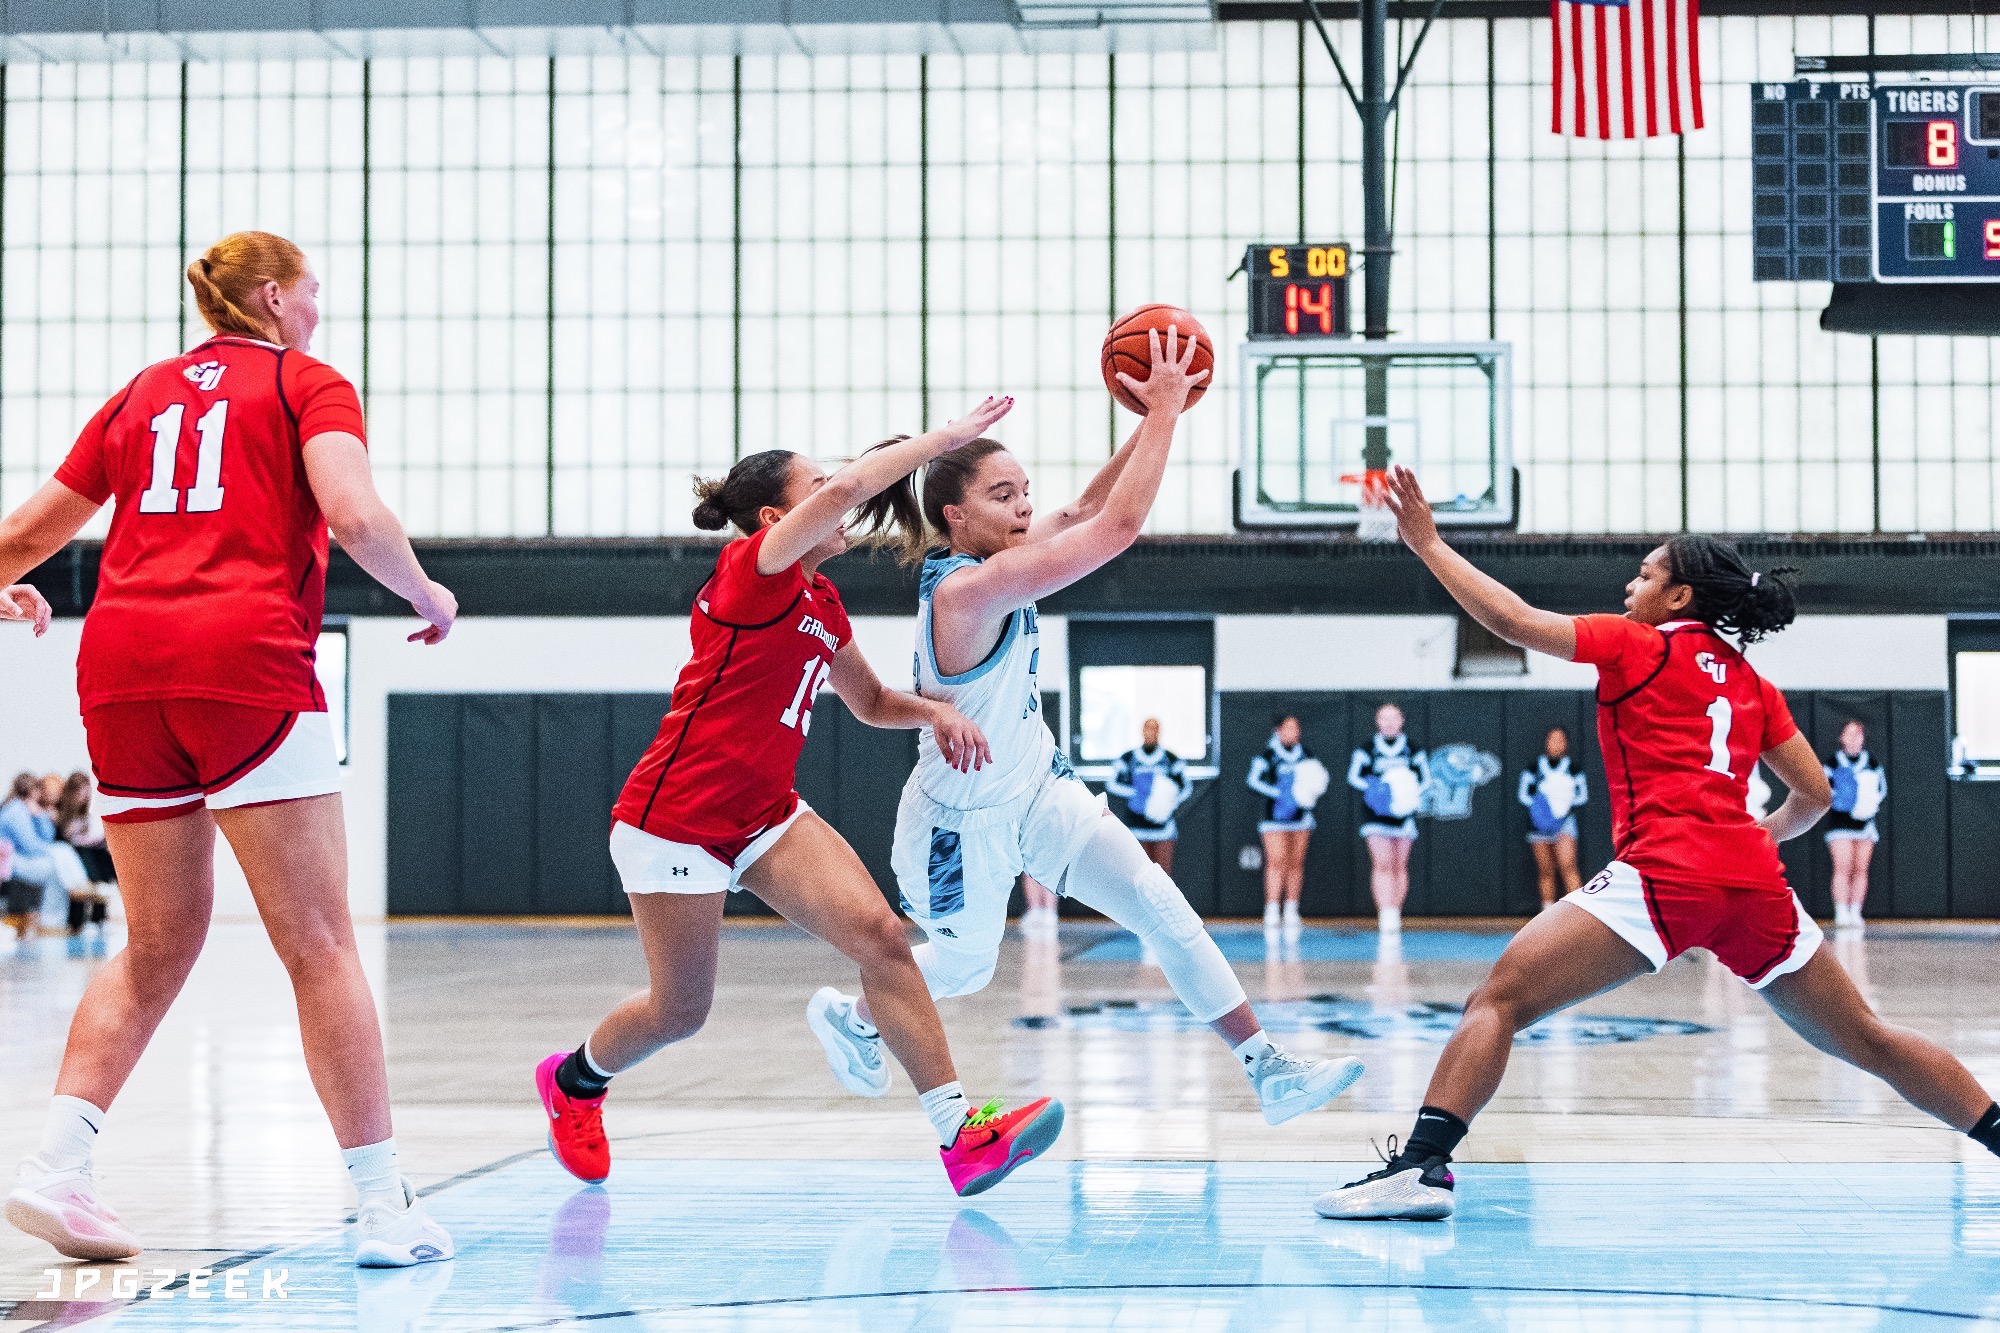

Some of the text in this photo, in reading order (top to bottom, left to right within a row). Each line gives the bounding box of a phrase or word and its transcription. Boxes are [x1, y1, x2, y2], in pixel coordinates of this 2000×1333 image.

[1763, 83, 1871, 100] NO F PTS
[1887, 90, 1960, 113] TIGERS
[1927, 120, 1958, 167] 8
[1912, 173, 1967, 191] BONUS
[1904, 203, 1955, 220] FOULS
[1943, 221, 1955, 258] 1
[1307, 247, 1346, 277] 00
[1285, 283, 1332, 335] 14
[138, 399, 230, 515] 11
[1703, 695, 1736, 780] 1
